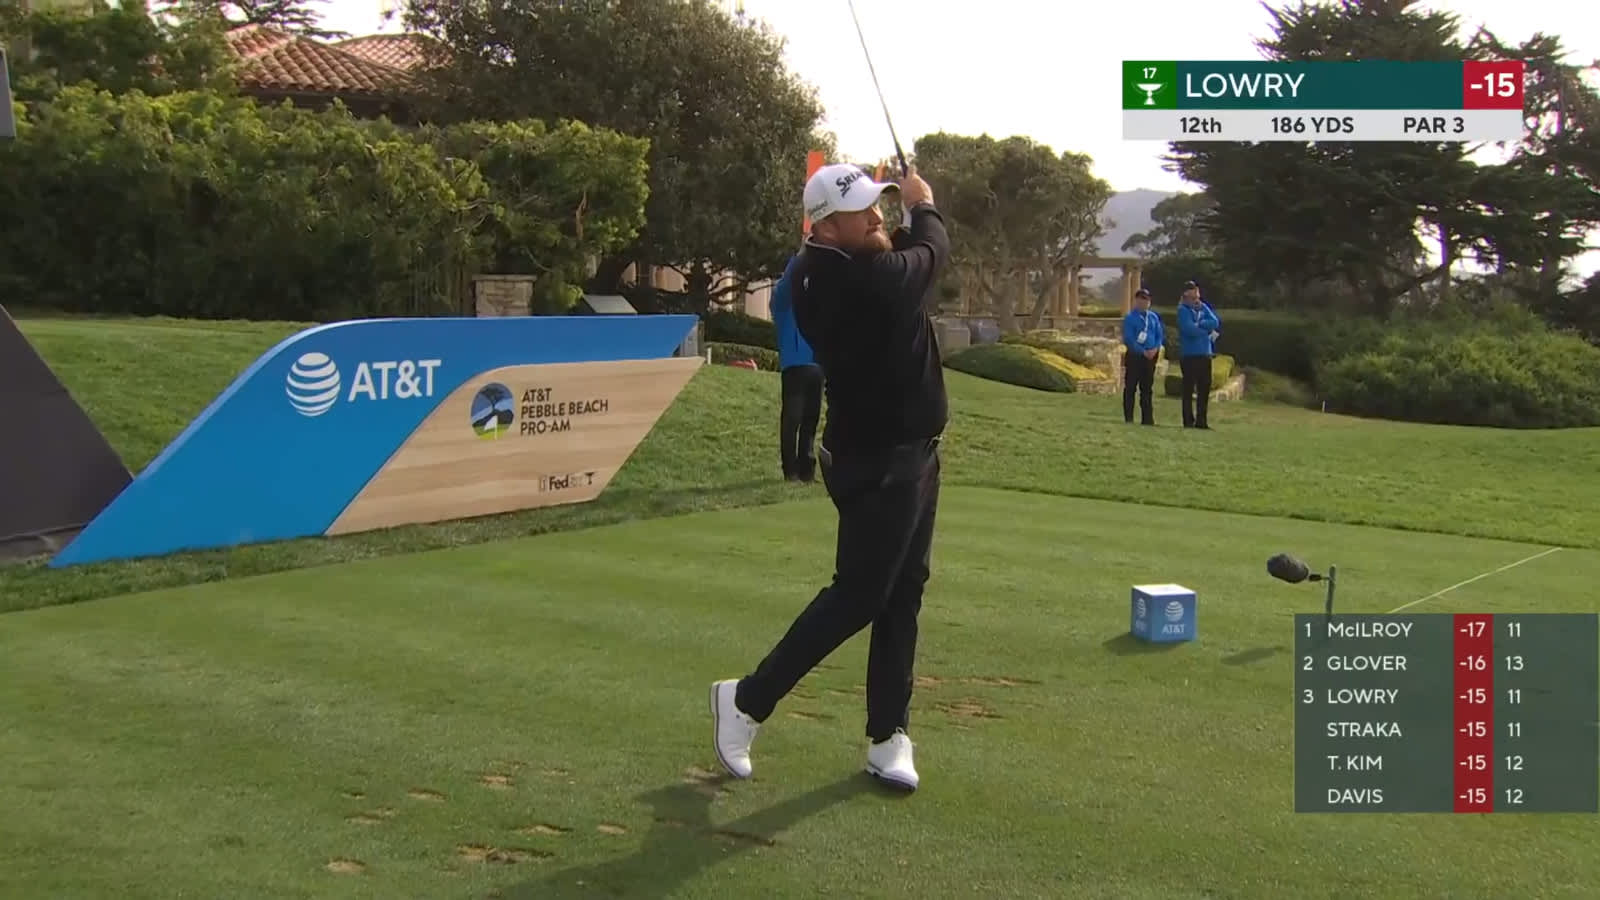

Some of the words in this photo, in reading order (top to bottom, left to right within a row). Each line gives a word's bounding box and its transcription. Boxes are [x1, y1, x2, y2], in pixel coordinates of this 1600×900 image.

[347, 359, 442, 403] AT&T
[521, 387, 552, 403] AT&T
[520, 402, 566, 419] PEBBLE
[568, 398, 609, 416] BEACH
[520, 417, 571, 436] PRO-AM
